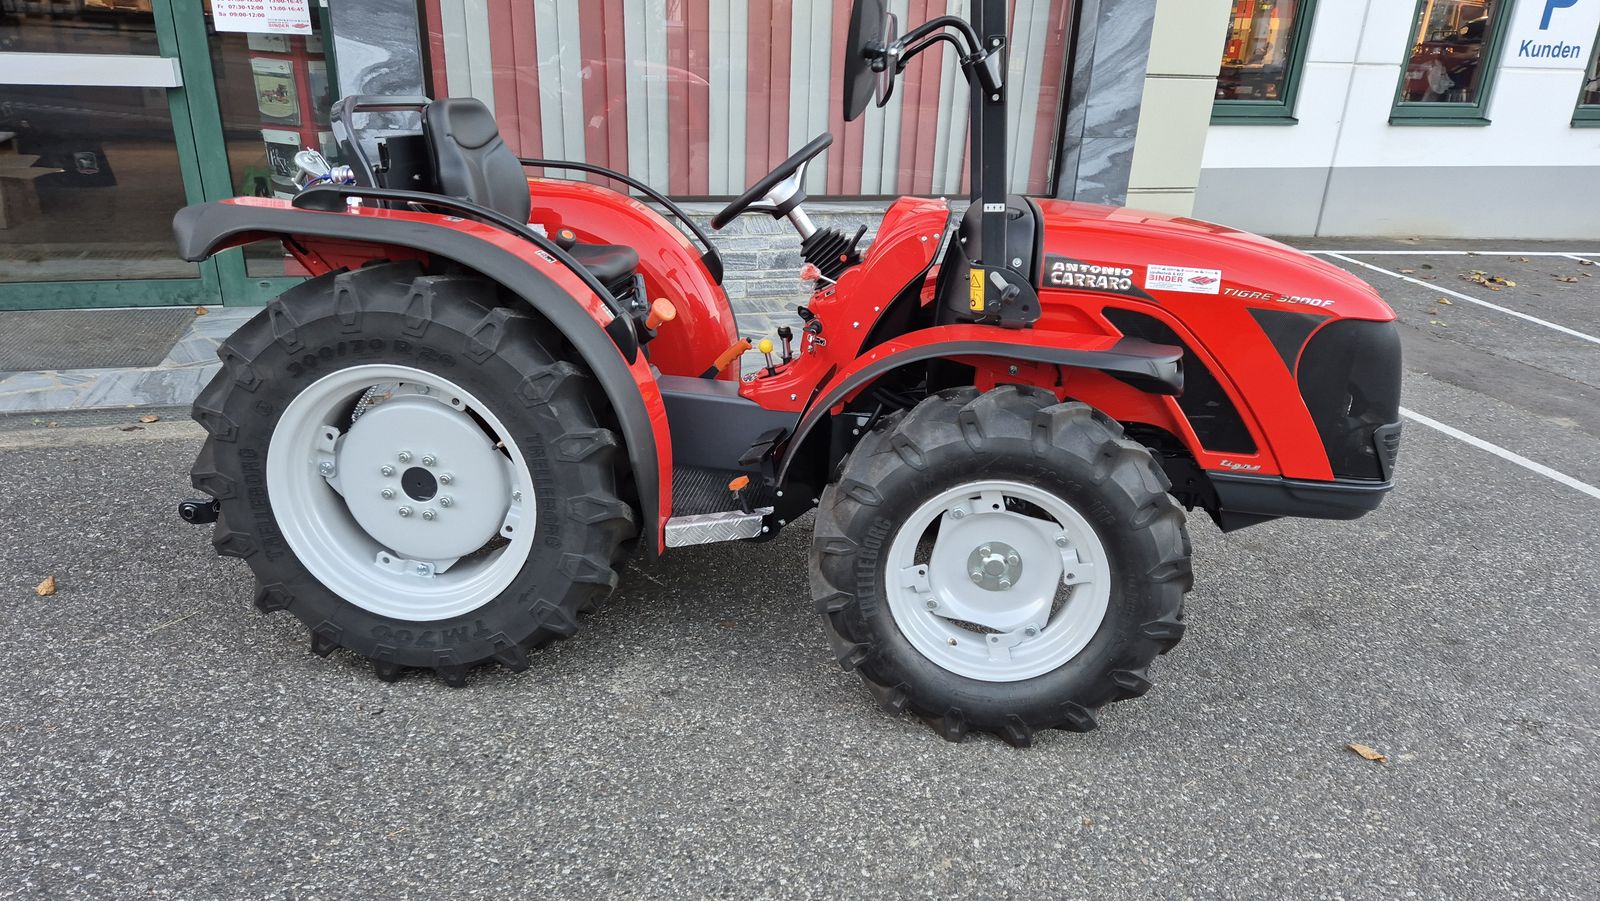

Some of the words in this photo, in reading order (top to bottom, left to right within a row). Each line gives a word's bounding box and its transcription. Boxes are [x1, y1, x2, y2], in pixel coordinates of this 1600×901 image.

[1519, 39, 1581, 58] Kunden
[1052, 262, 1134, 277] ANTONIO
[1050, 272, 1132, 291] CARRARO
[1149, 274, 1184, 283] BINDER
[1224, 287, 1274, 301] TIGRE
